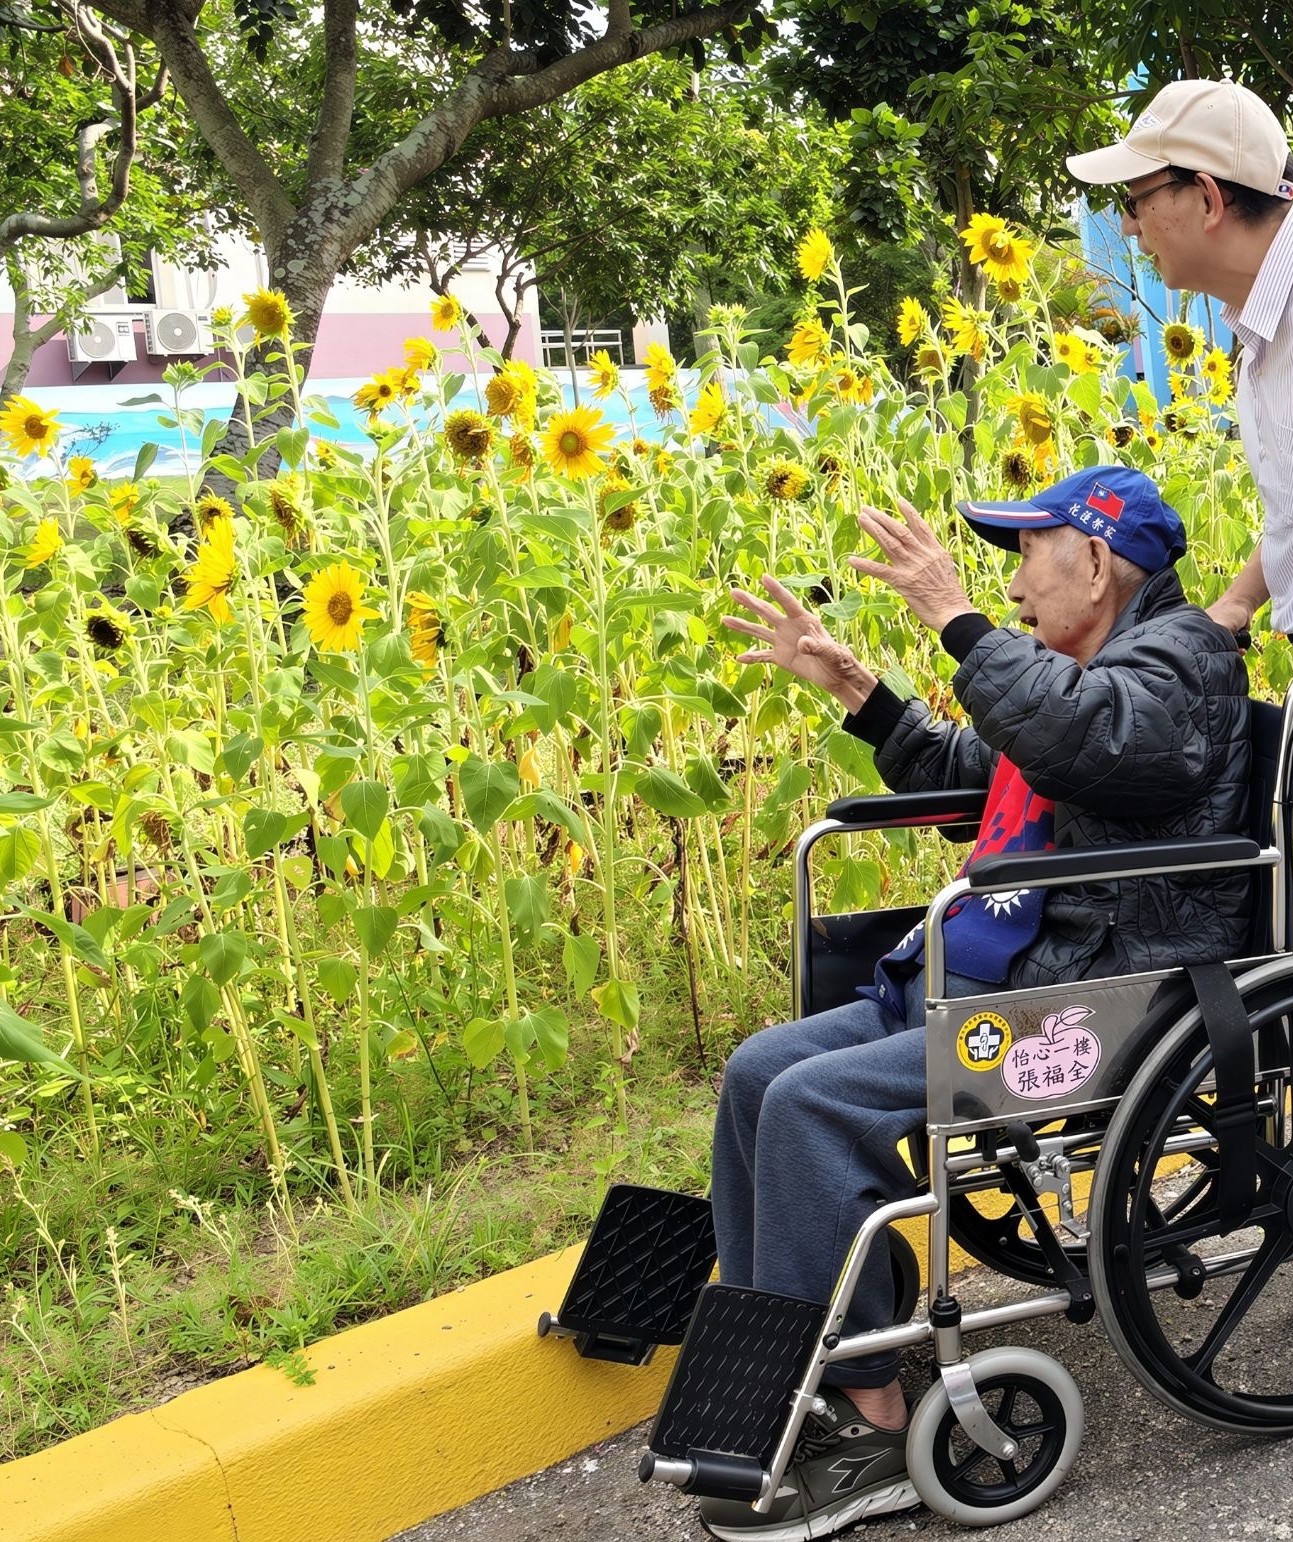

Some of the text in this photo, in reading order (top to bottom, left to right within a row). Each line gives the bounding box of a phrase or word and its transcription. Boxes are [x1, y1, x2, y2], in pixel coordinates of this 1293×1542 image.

[1012, 1036, 1092, 1069] 怡心一樓
[1018, 1060, 1089, 1092] 張福全
